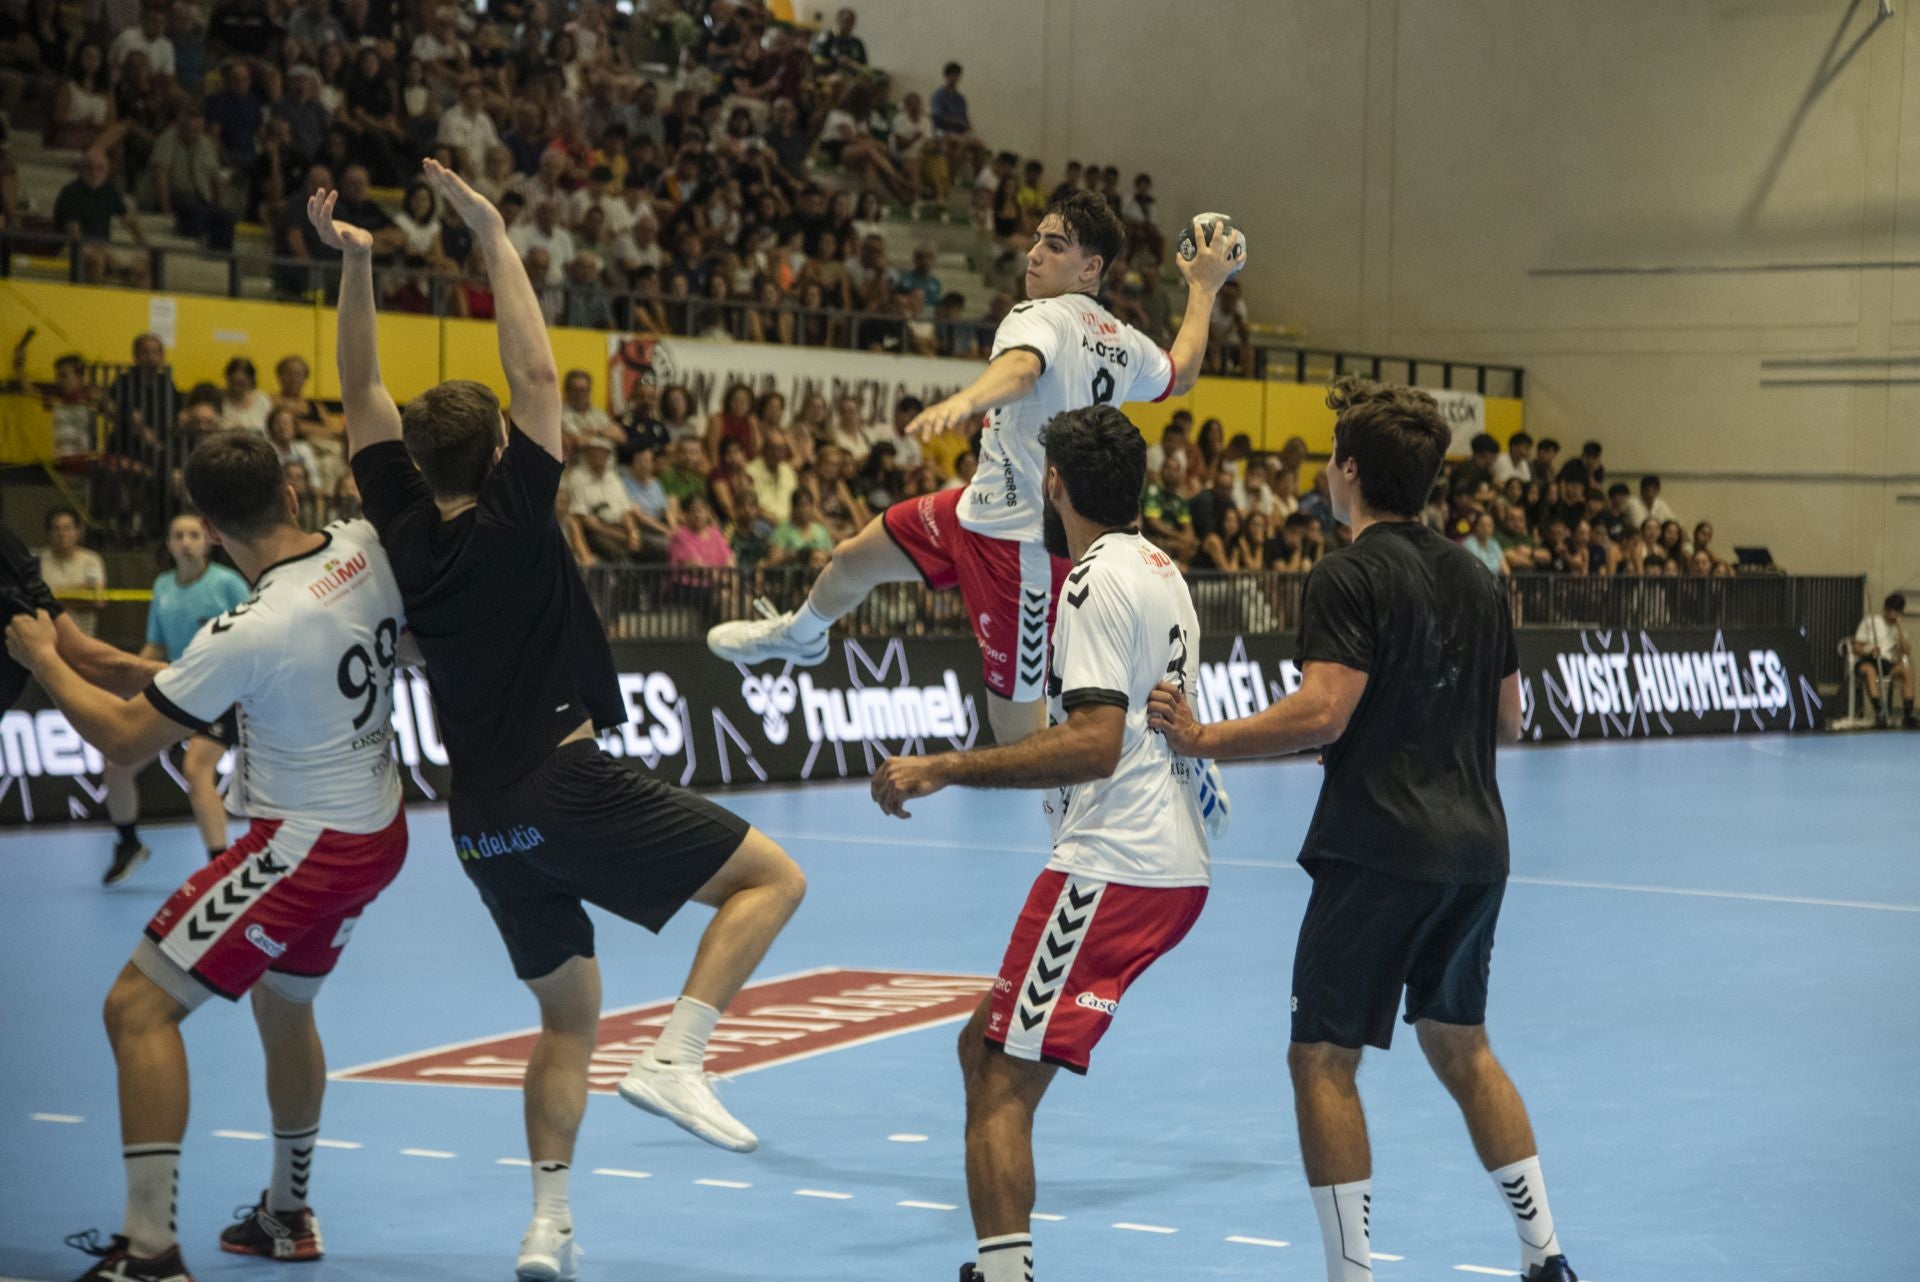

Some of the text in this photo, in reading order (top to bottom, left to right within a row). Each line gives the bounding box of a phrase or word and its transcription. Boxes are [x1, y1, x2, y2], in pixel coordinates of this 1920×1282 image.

[337, 617, 398, 731] 99
[798, 668, 968, 743] hummel
[1556, 651, 1633, 715] VISIT
[1632, 649, 1788, 714] HUMMEL.ES
